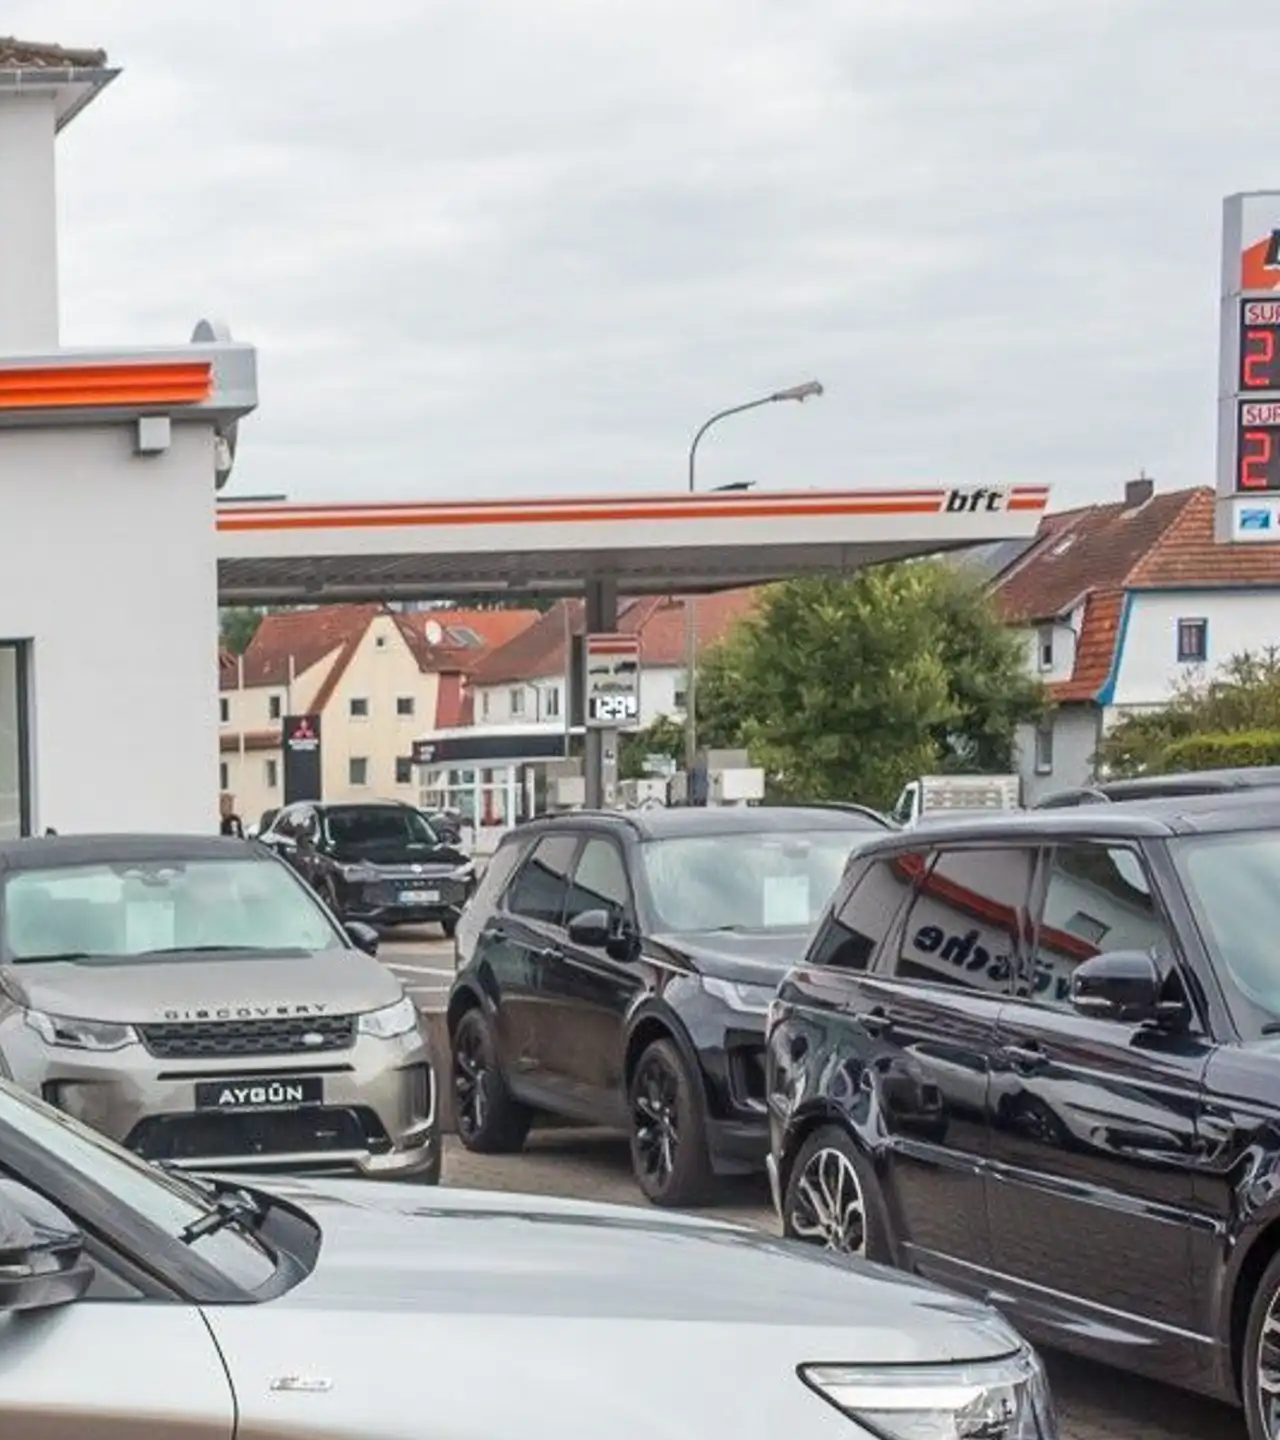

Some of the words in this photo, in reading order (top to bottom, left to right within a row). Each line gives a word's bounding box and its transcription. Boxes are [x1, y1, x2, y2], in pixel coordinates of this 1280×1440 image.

[945, 487, 1003, 513] bft
[164, 1003, 327, 1020] DISCOVERY
[218, 1082, 304, 1105] AYGÜN
